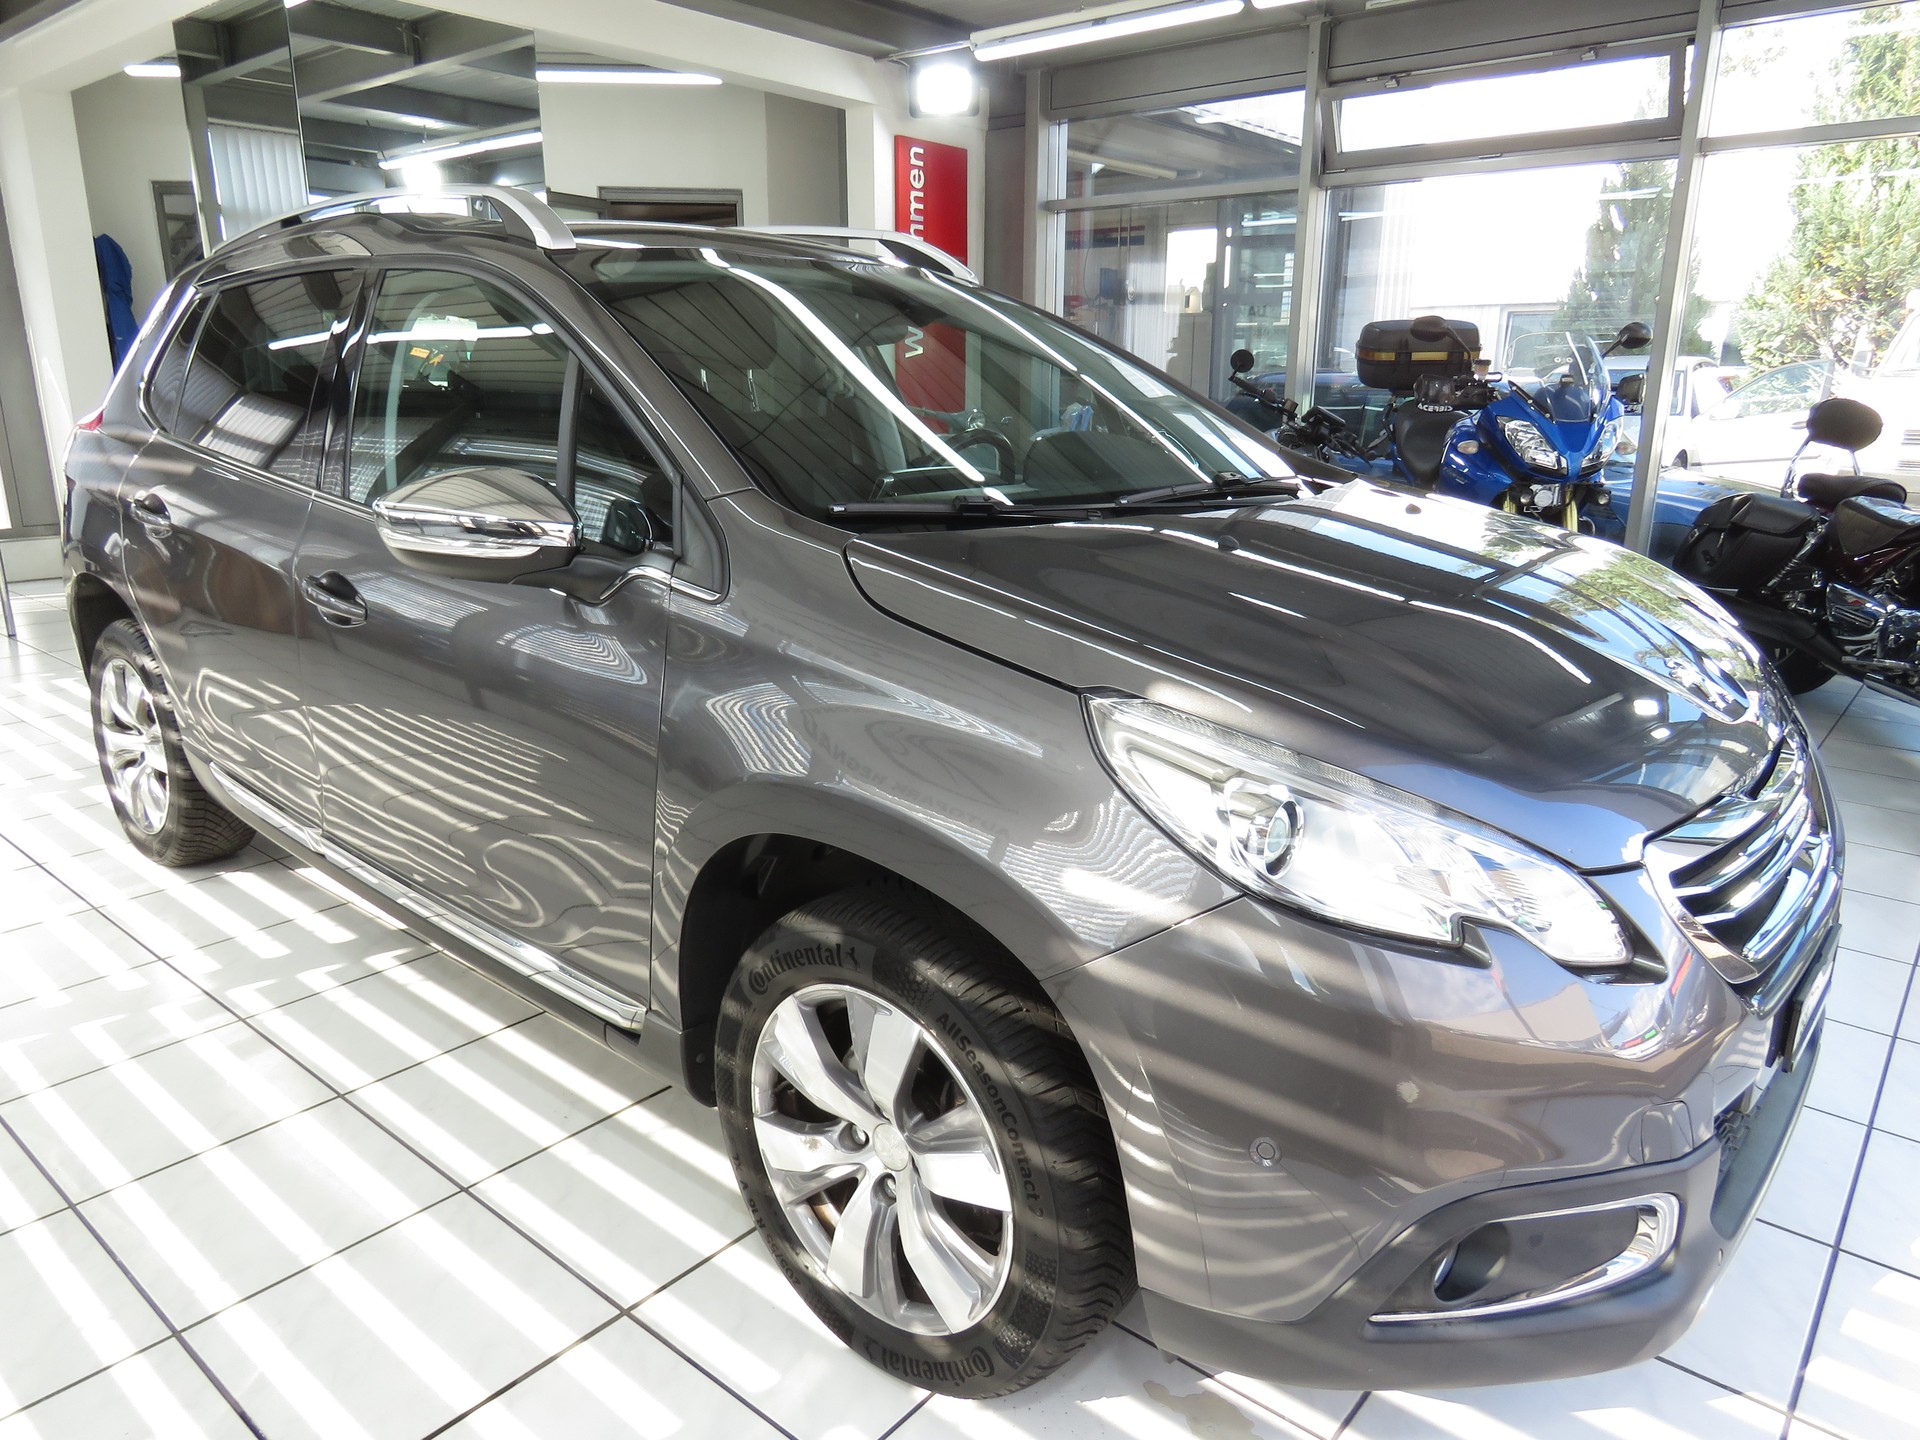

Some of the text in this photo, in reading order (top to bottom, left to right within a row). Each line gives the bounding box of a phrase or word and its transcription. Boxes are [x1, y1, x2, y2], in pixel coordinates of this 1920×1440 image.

[749, 943, 845, 995] Continental
[936, 1012, 1040, 1201] AllSeasonContact
[881, 1346, 995, 1387] Continental
